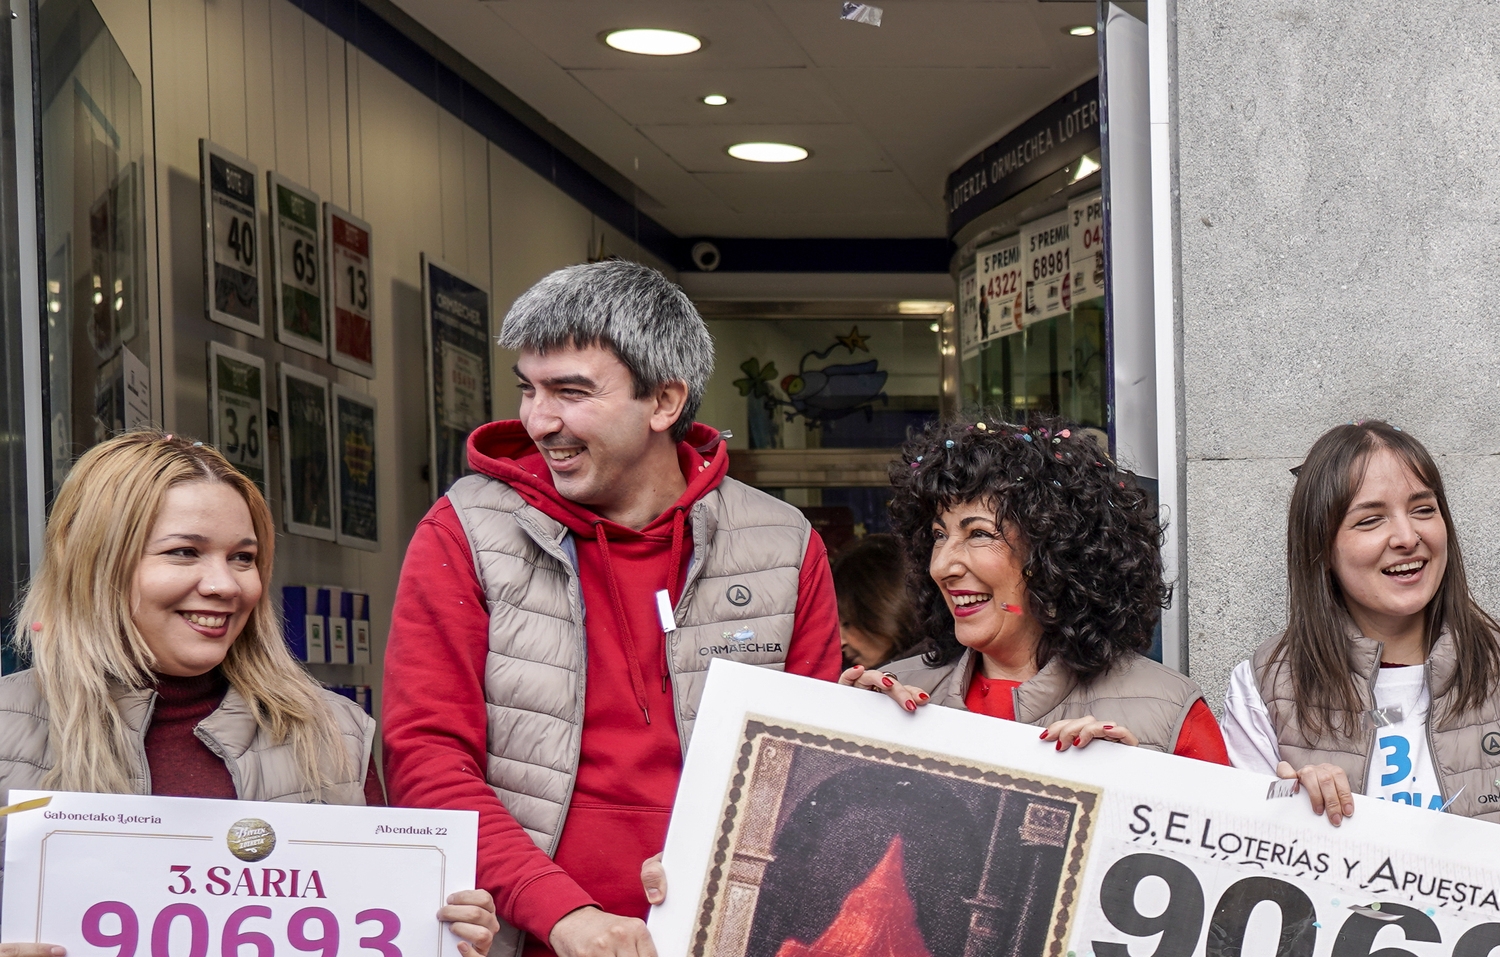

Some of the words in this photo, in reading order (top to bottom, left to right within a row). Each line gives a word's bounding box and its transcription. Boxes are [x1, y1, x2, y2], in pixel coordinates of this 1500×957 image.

[991, 128, 1054, 184] ORMAECHEA
[229, 216, 253, 266] 40
[293, 239, 316, 286] 65
[1033, 247, 1070, 281] 68981
[348, 265, 367, 310] 13
[699, 643, 782, 656] ORMAECHEA
[1379, 735, 1416, 787] 3.
[44, 810, 116, 823] Gabonetako
[117, 813, 162, 825] Loteria
[375, 824, 433, 836] Abenduak
[435, 827, 447, 836] 22
[168, 865, 197, 895] 3.
[205, 866, 327, 899] SARIA
